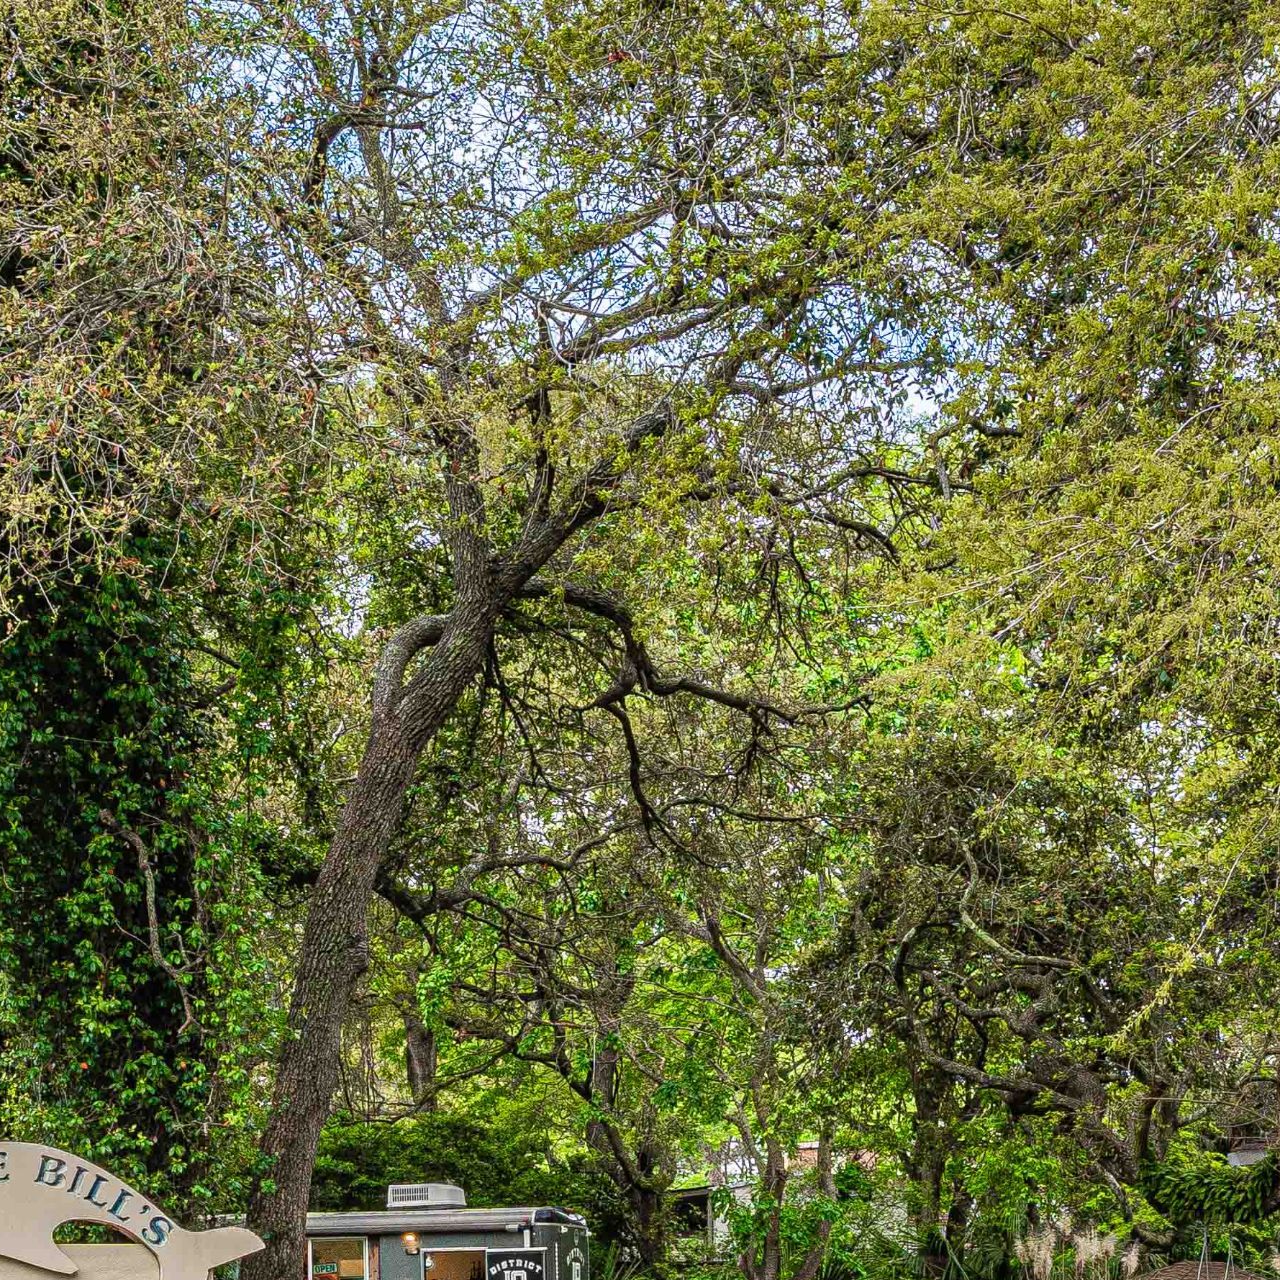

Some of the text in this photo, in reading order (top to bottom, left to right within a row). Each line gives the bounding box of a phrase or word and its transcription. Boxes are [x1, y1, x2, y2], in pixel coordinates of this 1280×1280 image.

[35, 1155, 175, 1248] BILL'S
[314, 1264, 335, 1273] OPEN
[489, 1258, 542, 1275] DISTRICT
